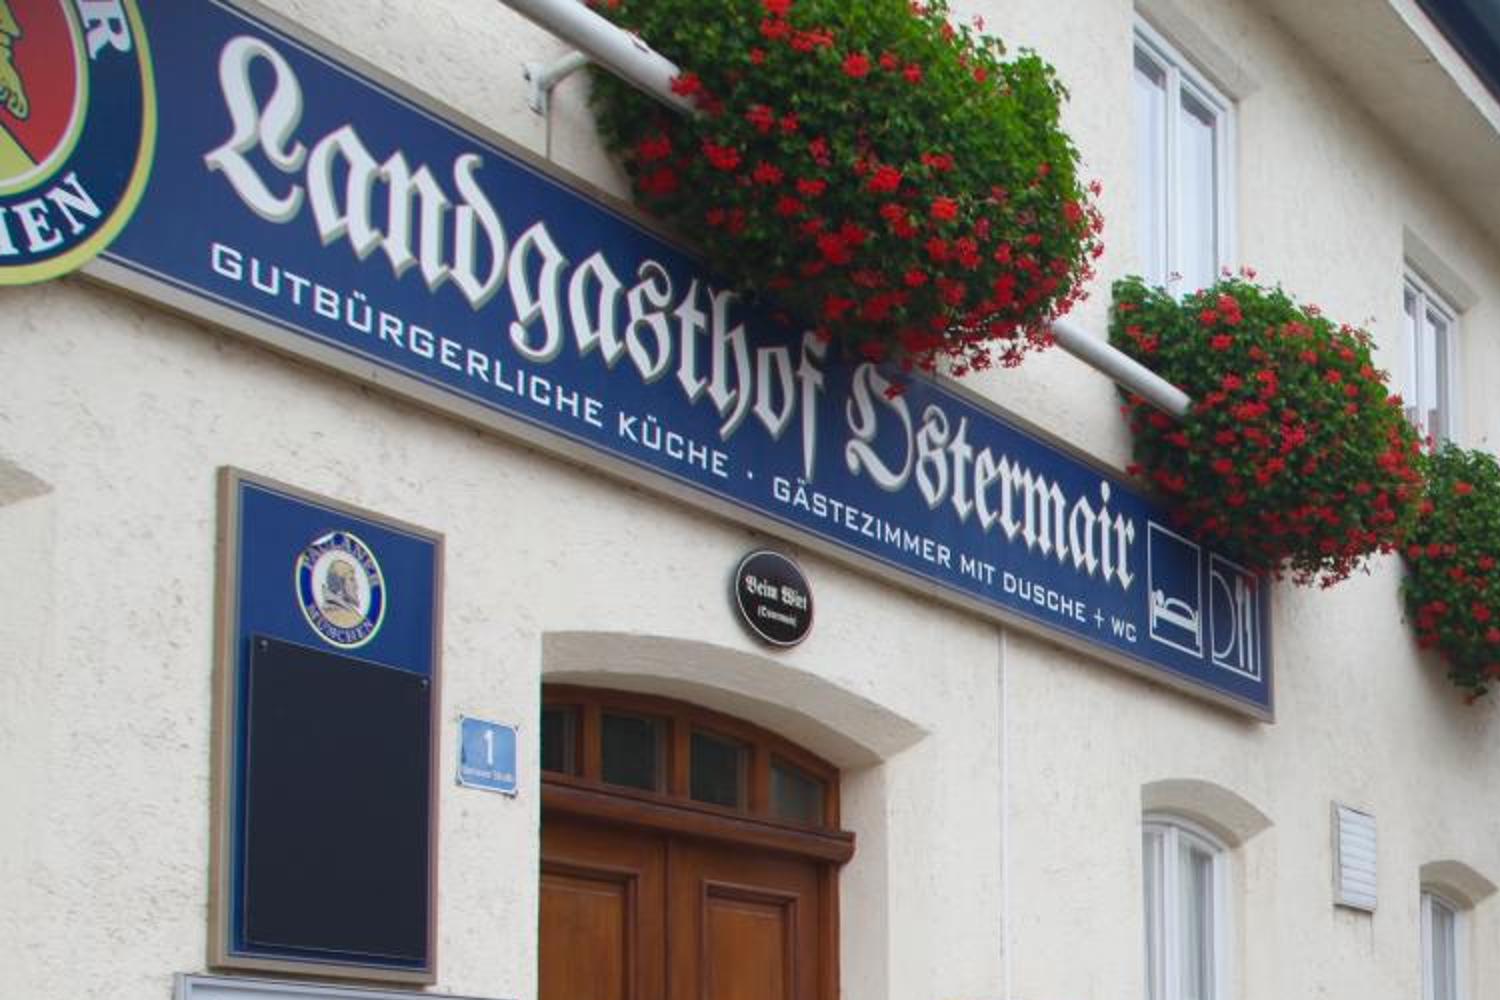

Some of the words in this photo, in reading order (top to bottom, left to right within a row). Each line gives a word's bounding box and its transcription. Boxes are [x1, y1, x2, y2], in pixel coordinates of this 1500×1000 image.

[205, 34, 829, 483] Landgasthof
[845, 361, 1137, 592] Ostermair
[210, 241, 604, 428] GUTBÜRGERLICHE
[618, 410, 729, 479] KÜCHE
[773, 475, 951, 569] GÄSTEZIMMER
[960, 554, 996, 585] MIT
[1003, 573, 1087, 623] DUSCHE
[1094, 608, 1105, 631] +
[1111, 616, 1137, 643] WC
[483, 729, 494, 767] 1
